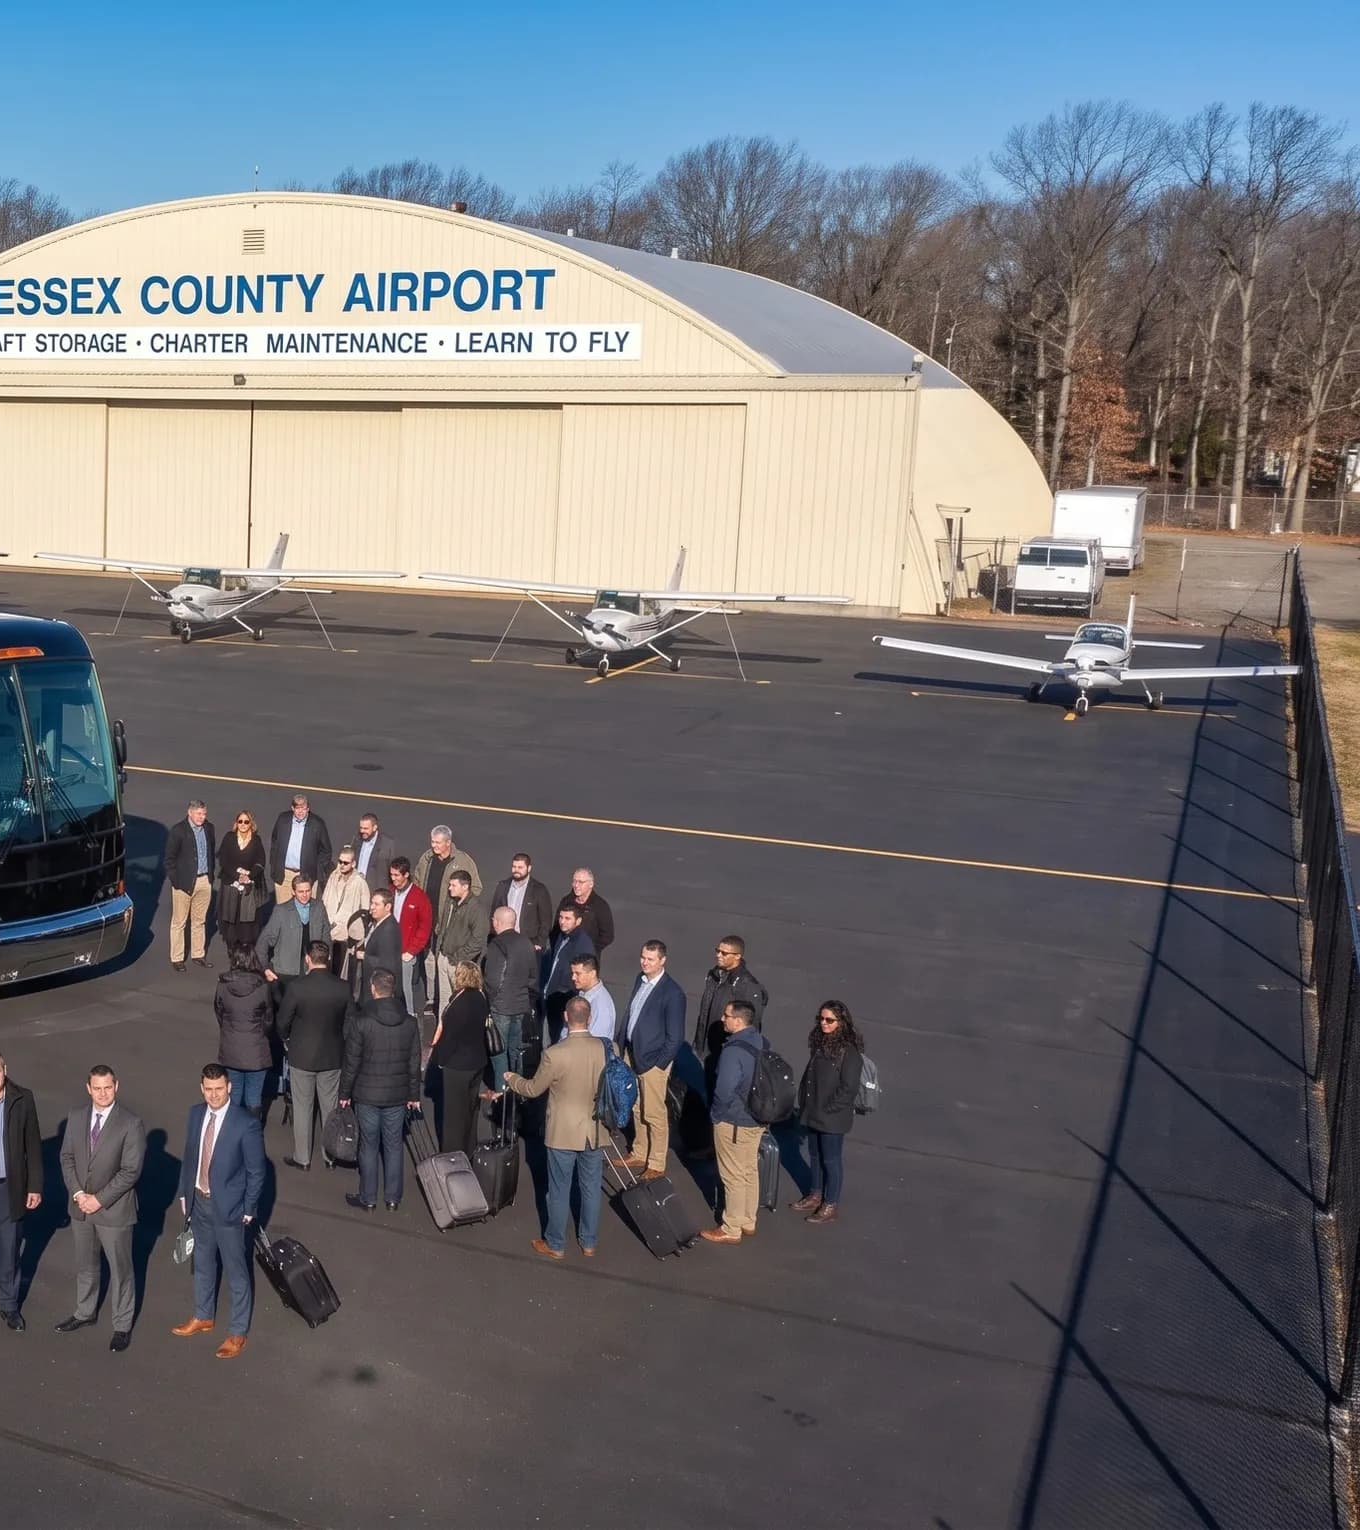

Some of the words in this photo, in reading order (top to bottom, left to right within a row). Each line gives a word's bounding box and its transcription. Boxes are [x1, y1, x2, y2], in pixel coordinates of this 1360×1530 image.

[140, 275, 324, 314] COUNTY
[343, 269, 555, 312] AIRPORT
[35, 333, 127, 353] STORAGE
[150, 333, 248, 353] CHARTER
[266, 332, 428, 353] MAINTENANCE
[455, 331, 533, 353] LEARN
[545, 331, 577, 353] TO
[589, 331, 630, 353] FLY
